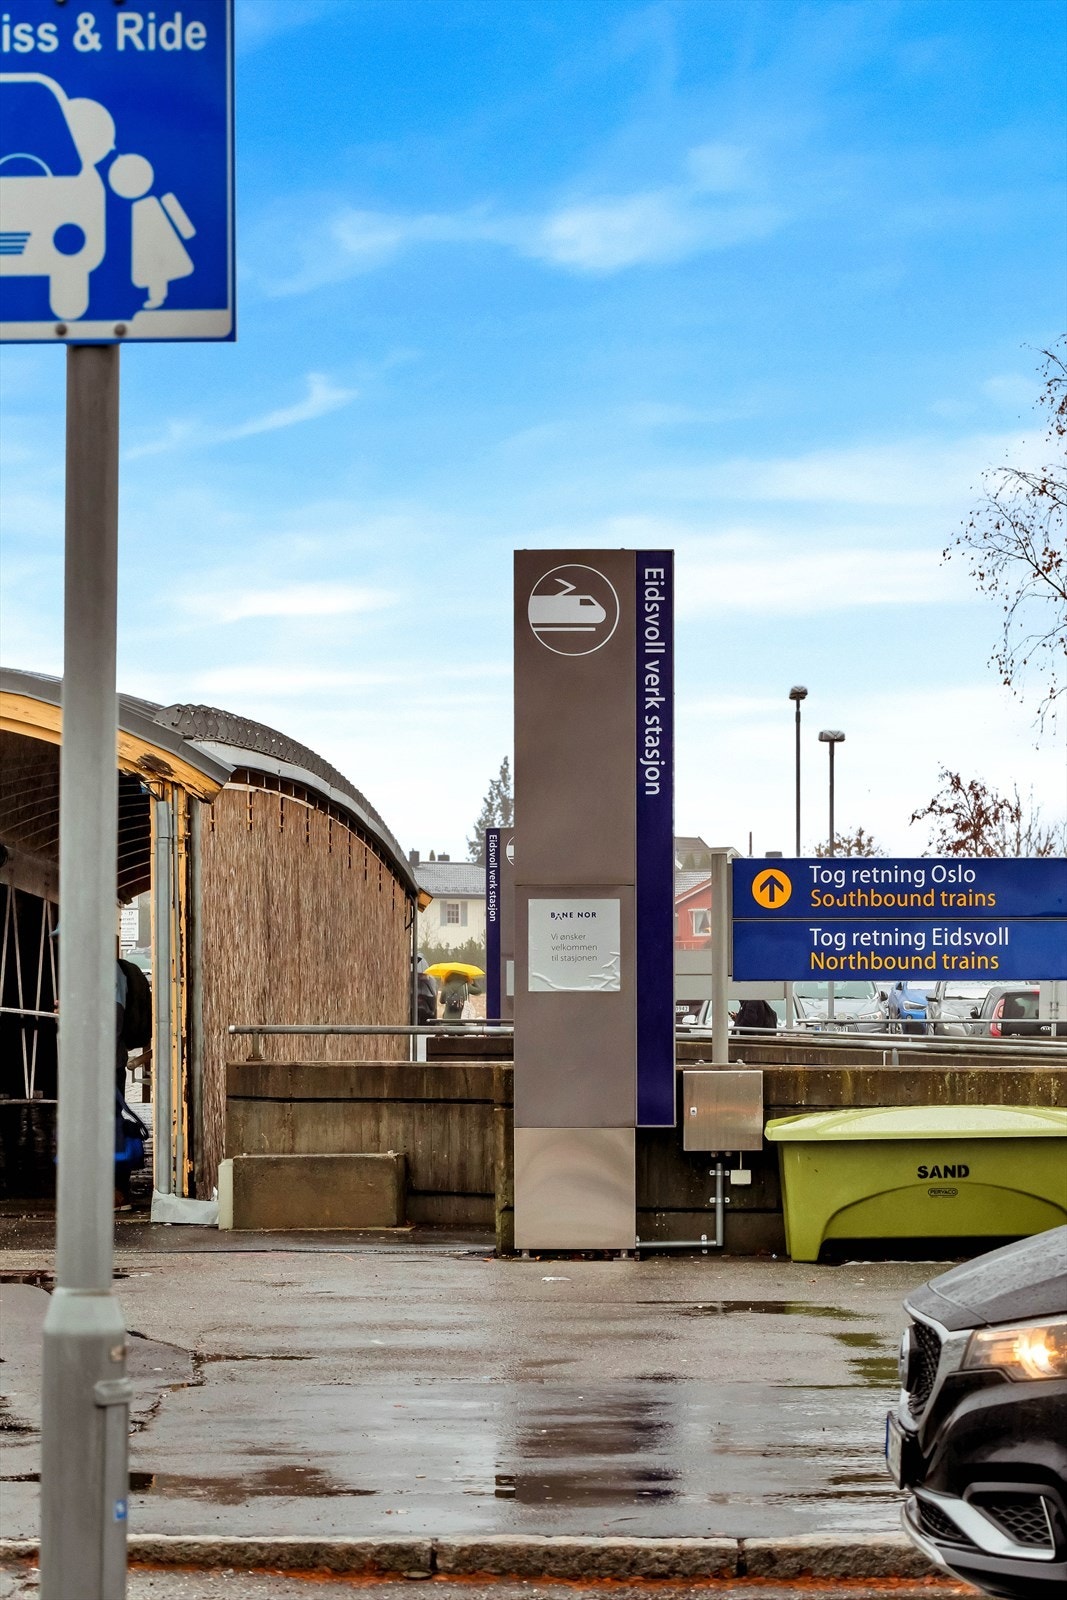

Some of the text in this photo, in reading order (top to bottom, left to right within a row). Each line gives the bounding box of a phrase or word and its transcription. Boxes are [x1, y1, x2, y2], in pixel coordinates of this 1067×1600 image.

[2, 12, 208, 52] iss & Ride
[639, 568, 666, 795] Eidsvoll verk stasjon
[487, 834, 498, 922] Eidsvoll verk stasjon
[809, 864, 976, 888] Tog retning Oslo
[810, 888, 997, 907] Southbound trains
[550, 911, 574, 920] BANE
[551, 943, 598, 951] velkommen
[809, 927, 1009, 951] Tog retning Eidsvoll
[560, 954, 598, 962] stasjonen
[810, 951, 999, 970] Northbound trains
[917, 1164, 970, 1179] SAND
